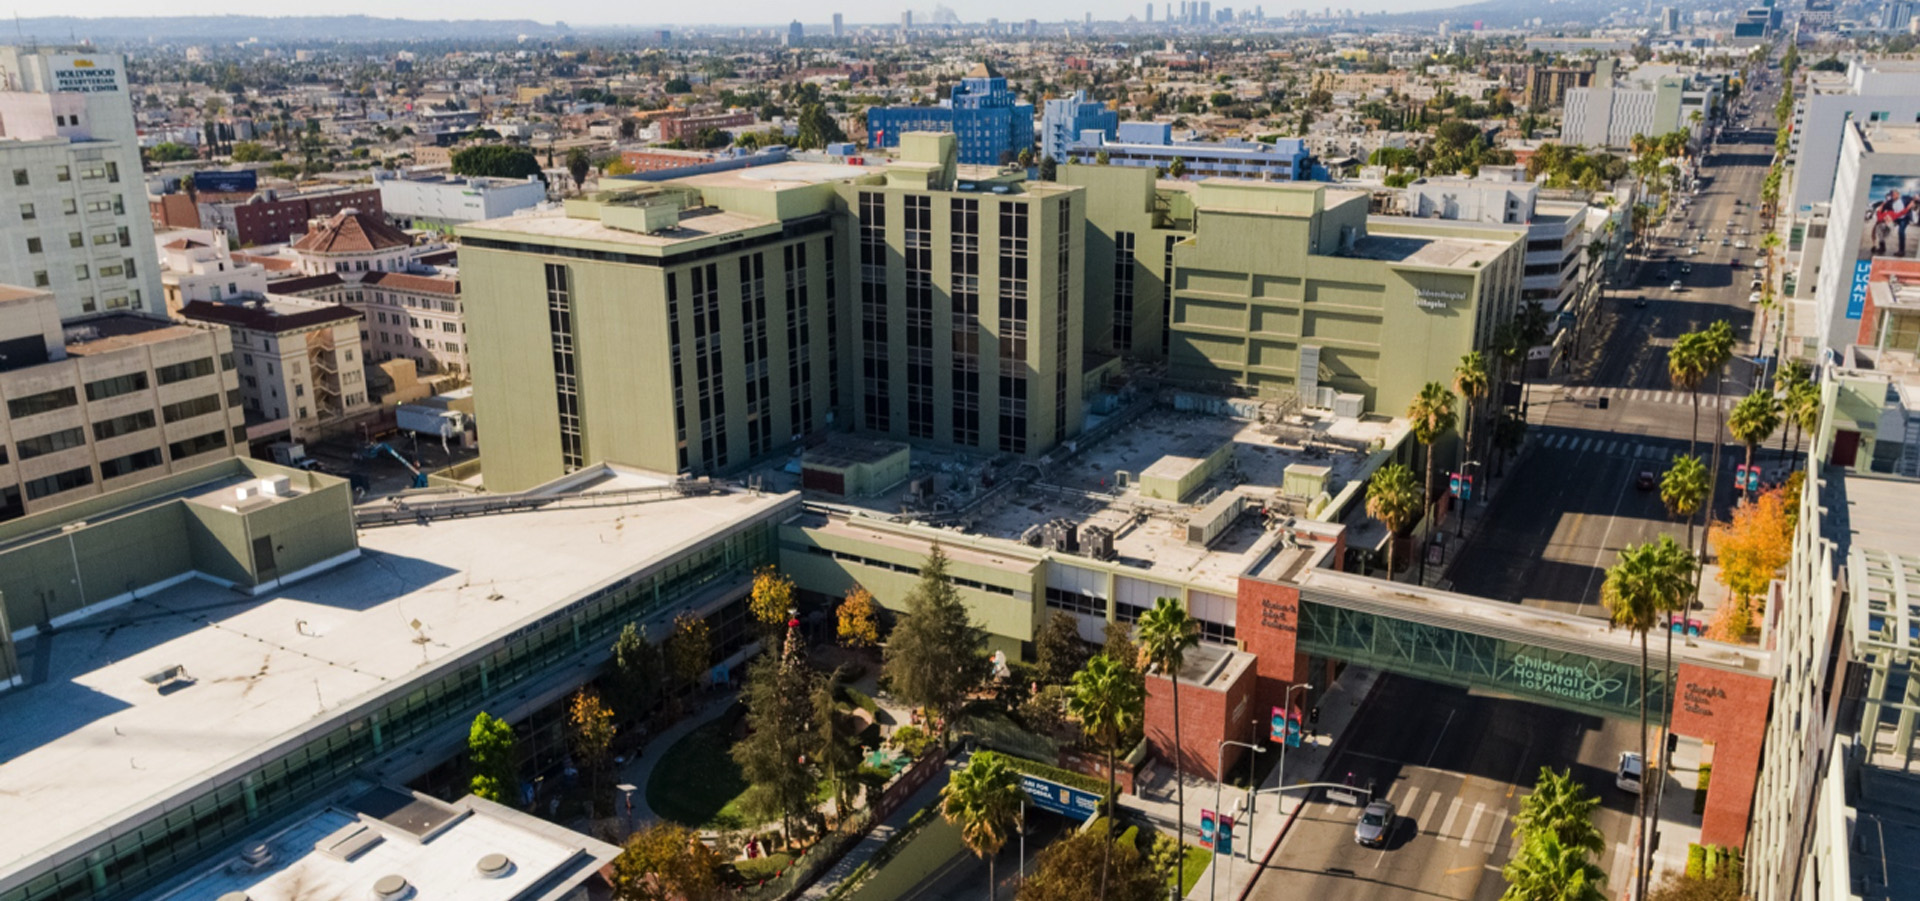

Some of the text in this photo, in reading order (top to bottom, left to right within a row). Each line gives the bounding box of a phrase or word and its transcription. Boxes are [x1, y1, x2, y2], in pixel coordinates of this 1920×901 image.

[55, 68, 115, 78] HOLLYWOOD
[59, 78, 115, 86] PRESBYTERIAN
[91, 84, 119, 92] CENTER
[1514, 655, 1583, 678] Children's
[1514, 667, 1578, 688] Hospital
[1520, 679, 1591, 701] LOS ANGELES
